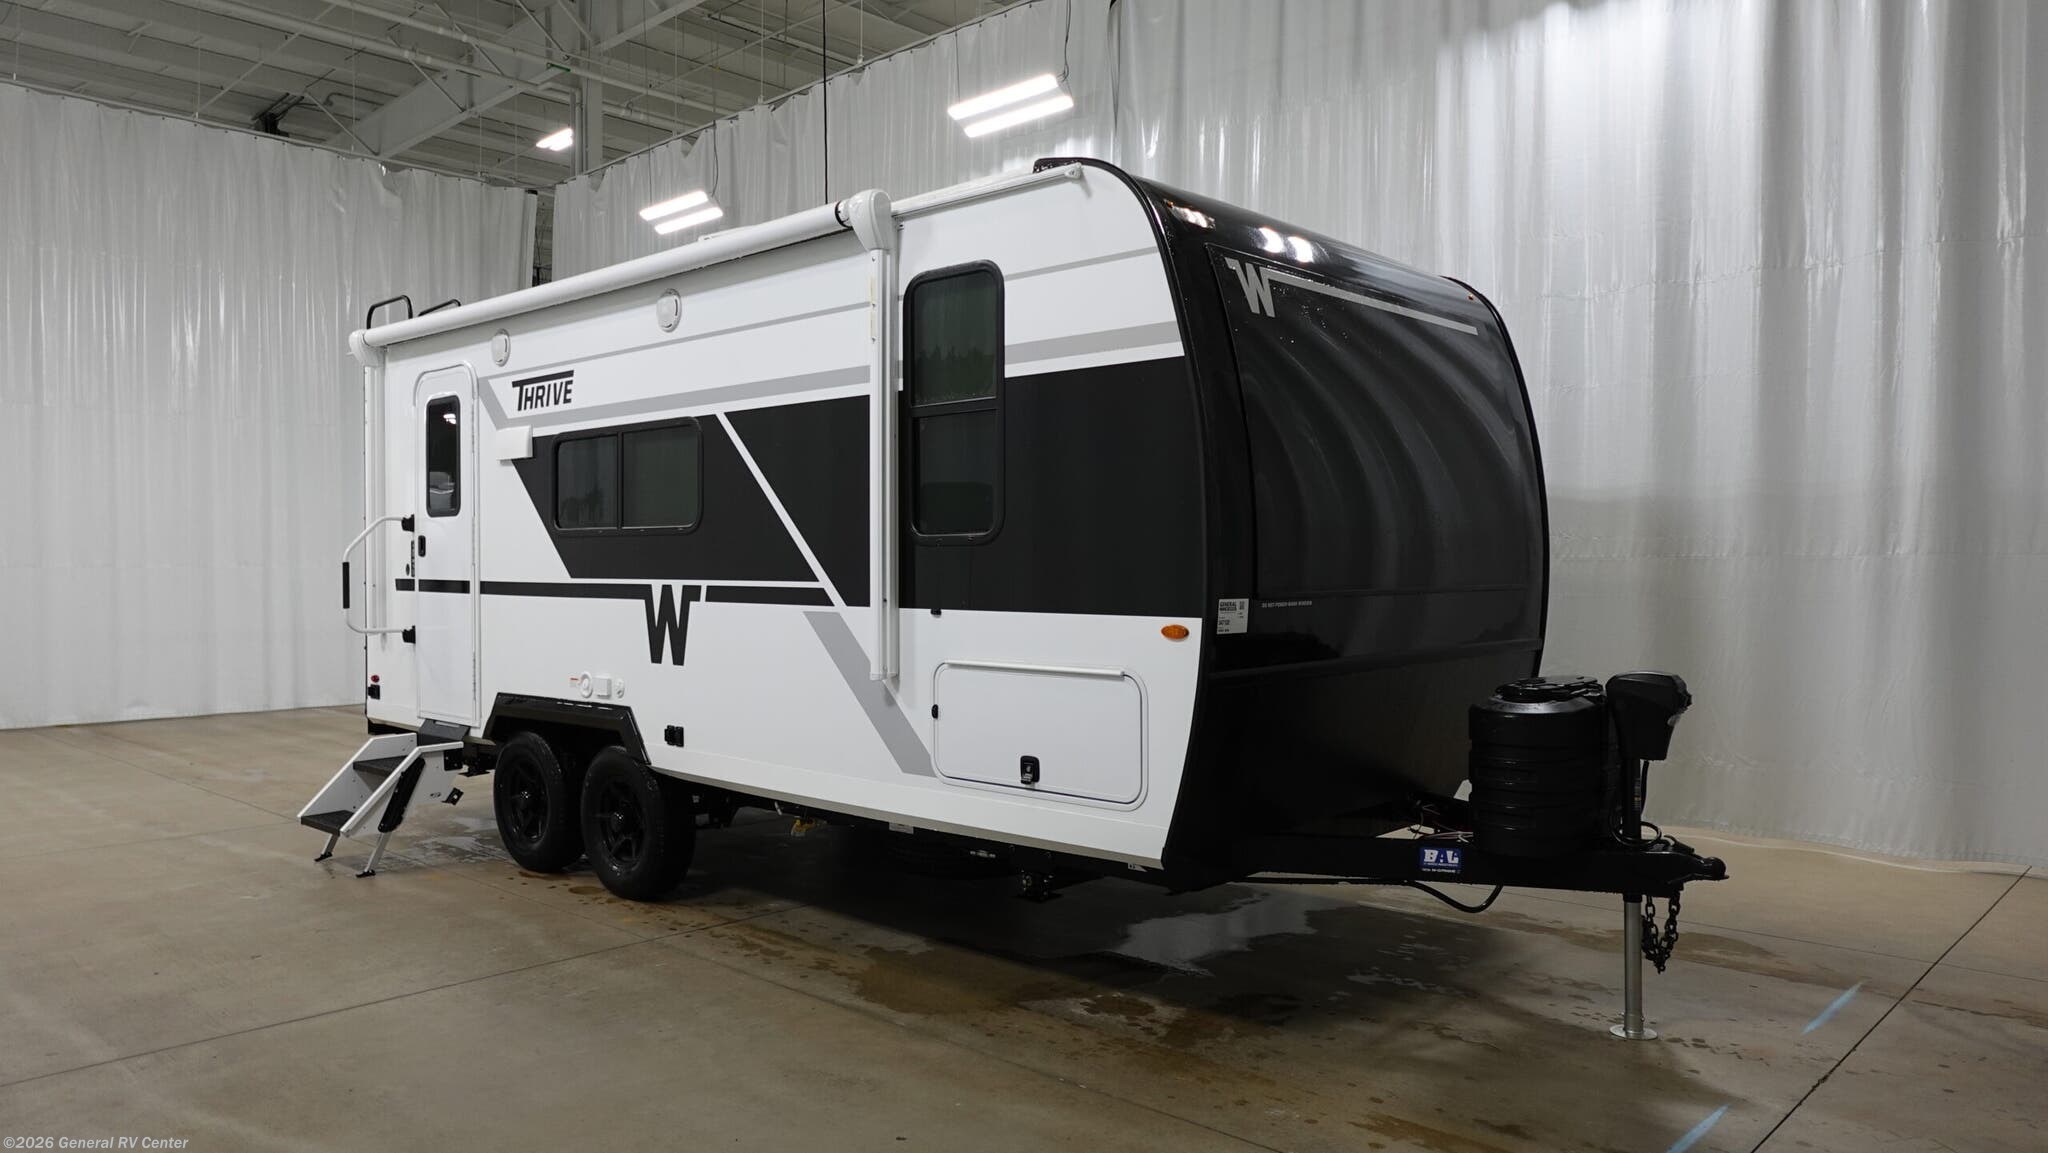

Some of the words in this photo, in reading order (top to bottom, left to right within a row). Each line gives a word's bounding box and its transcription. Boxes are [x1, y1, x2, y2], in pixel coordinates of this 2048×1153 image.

[1225, 257, 1276, 318] W
[512, 370, 574, 411] THRIVE
[644, 584, 701, 666] W
